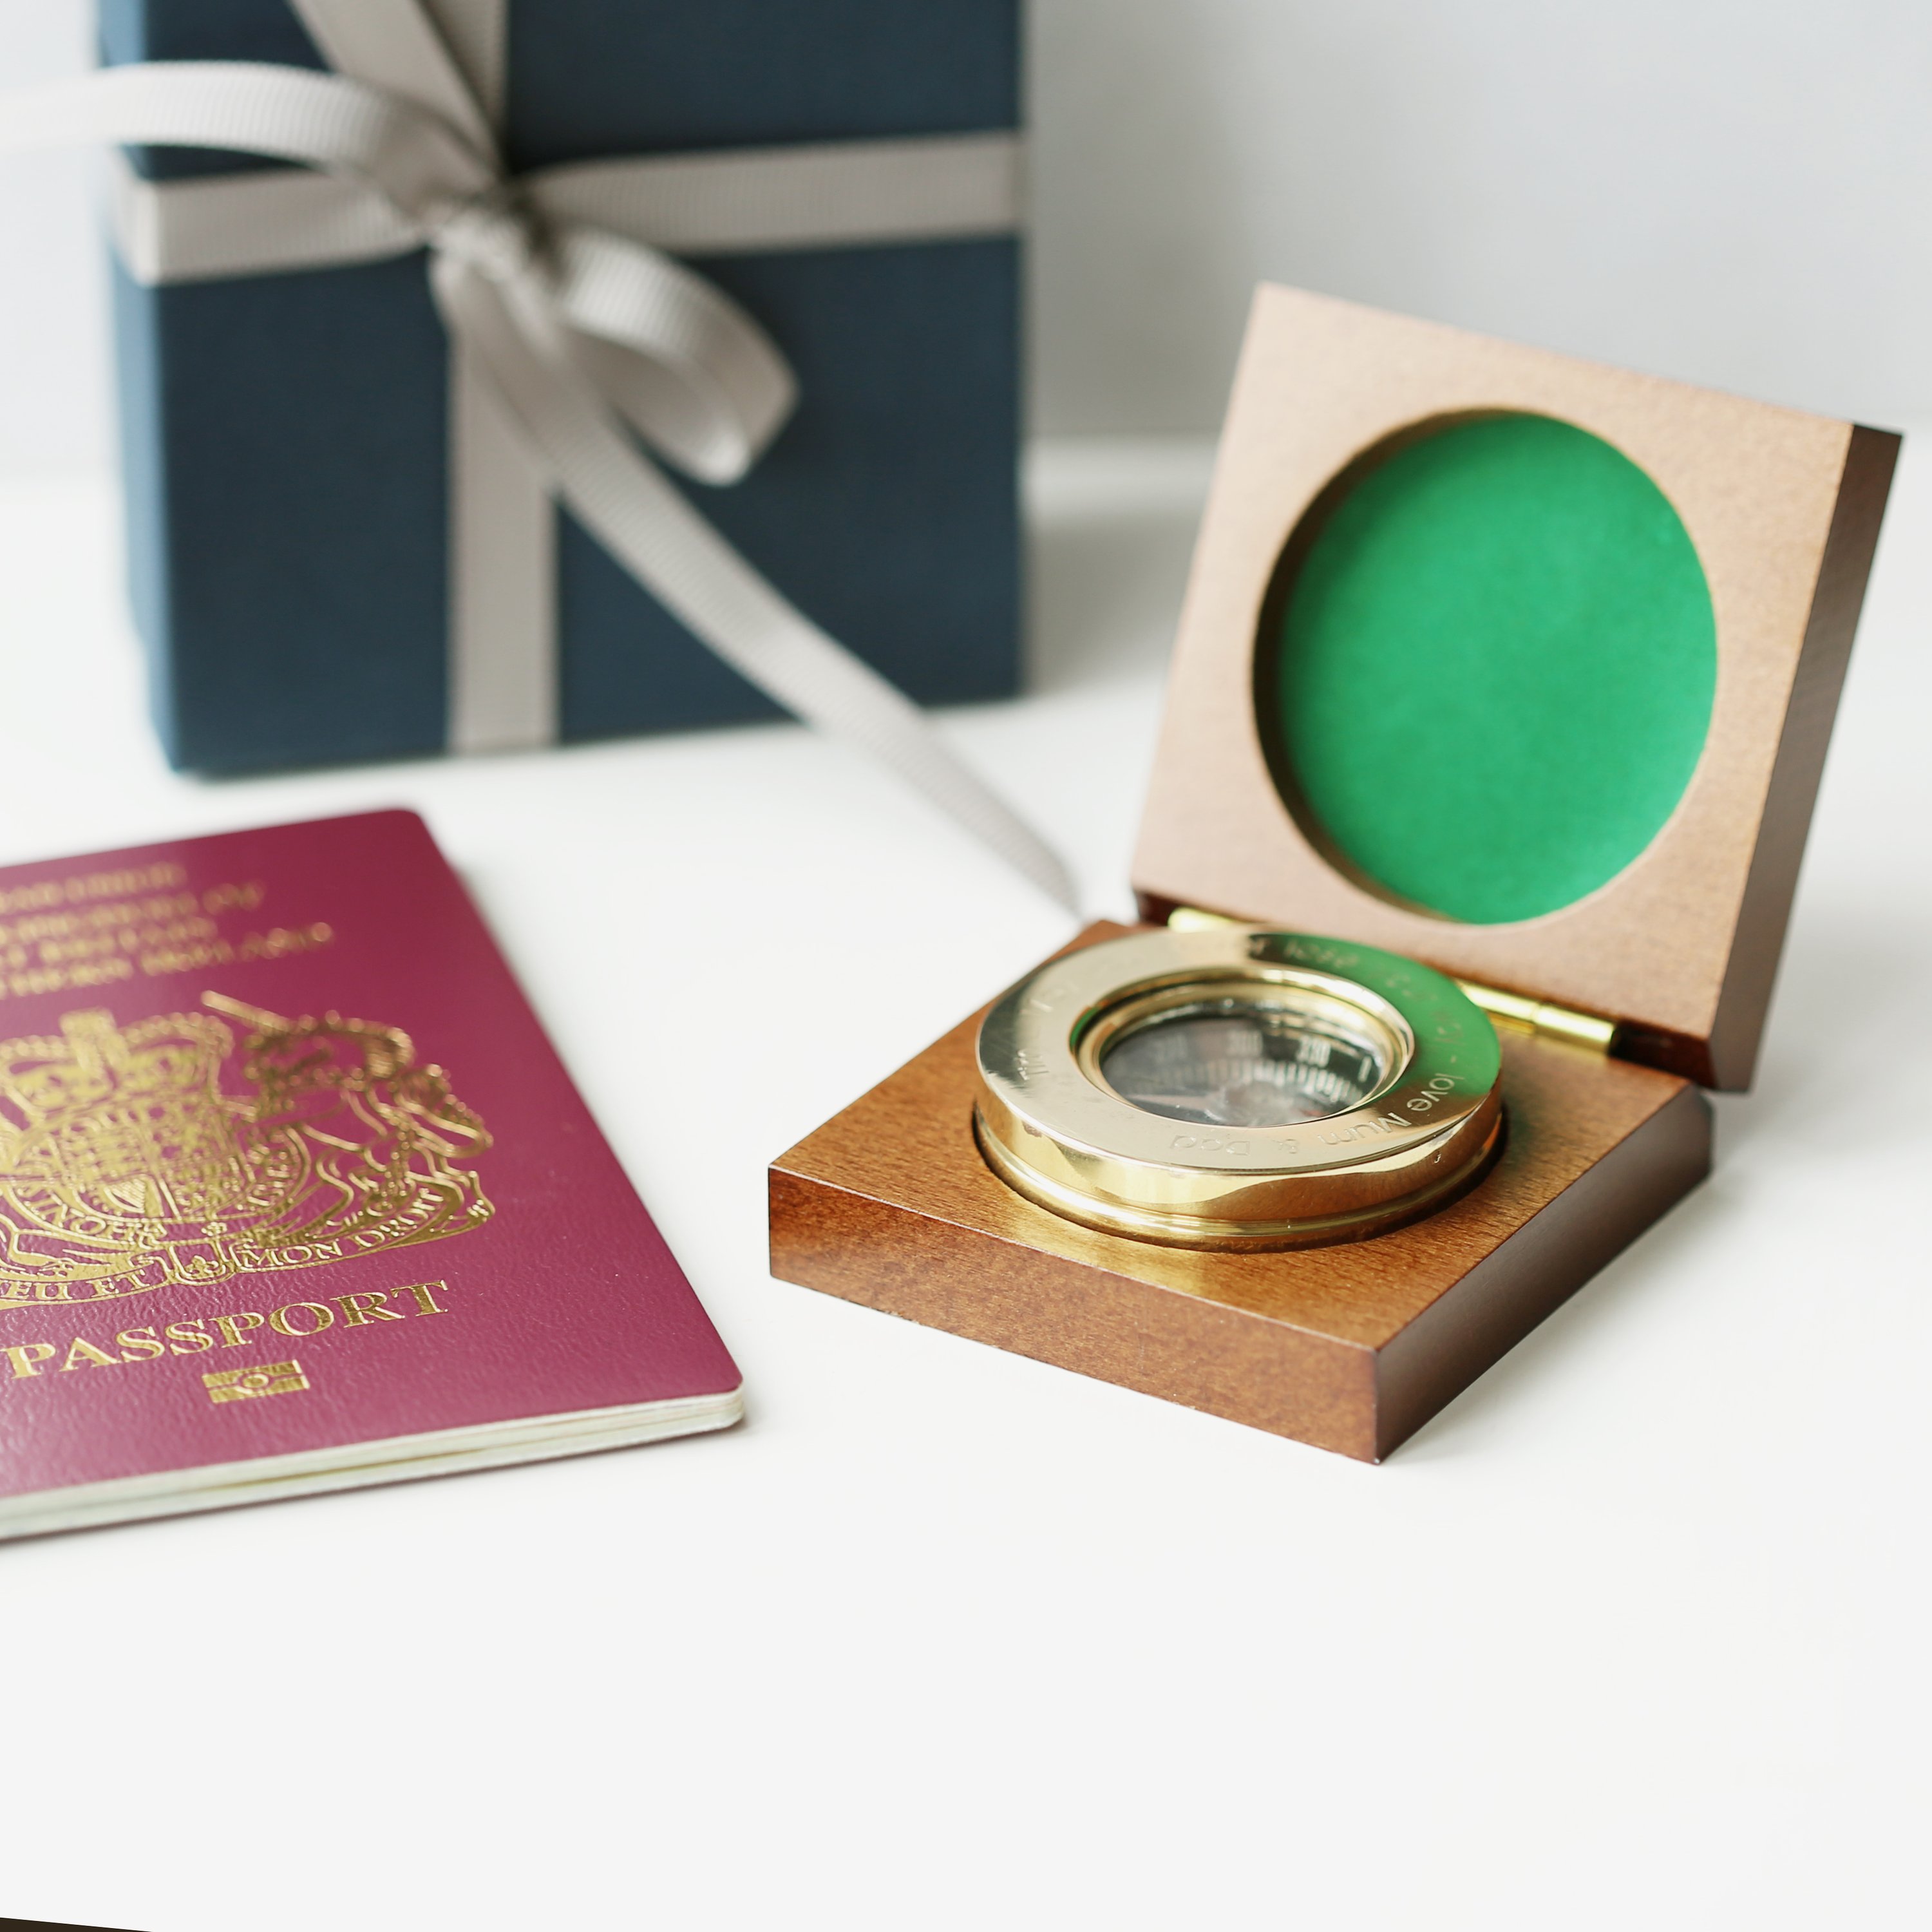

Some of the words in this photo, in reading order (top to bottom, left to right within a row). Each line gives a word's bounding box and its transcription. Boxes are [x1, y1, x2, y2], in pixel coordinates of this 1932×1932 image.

[1406, 1073, 1465, 1112] love
[1170, 1134, 1251, 1157] Dad
[1272, 1137, 1301, 1155] &
[1317, 1112, 1412, 1146] Mum
[85, 1269, 151, 1298] ET
[236, 1238, 343, 1267] MON
[0, 1280, 449, 1379] PASSPORT
